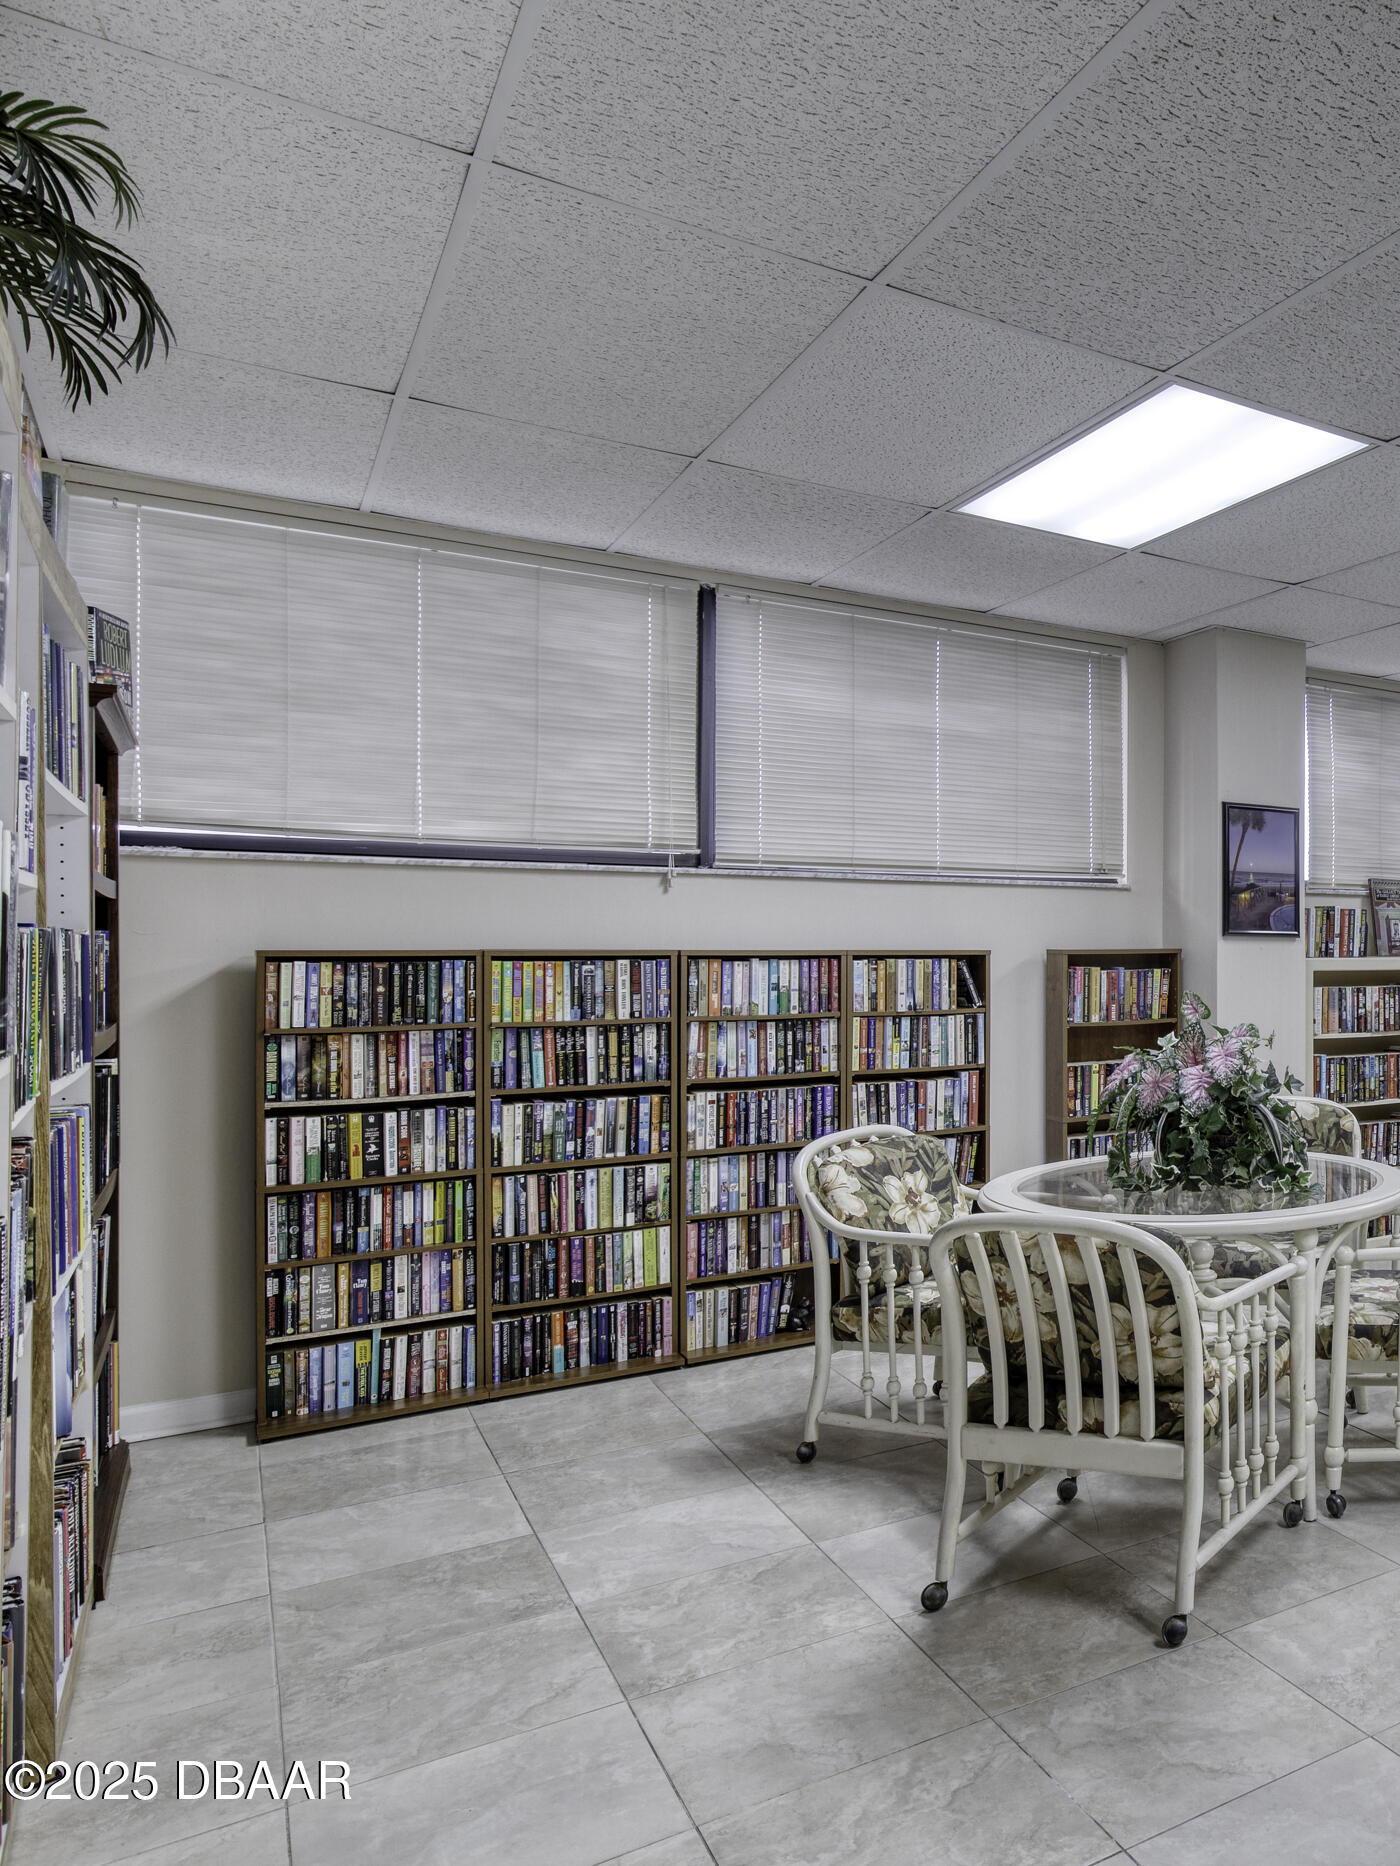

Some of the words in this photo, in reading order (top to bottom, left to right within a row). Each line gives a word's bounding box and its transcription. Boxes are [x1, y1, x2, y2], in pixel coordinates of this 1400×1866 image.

[103, 621, 128, 648] ROBERT
[100, 640, 131, 673] LUDLUM
[266, 1051, 277, 1062] DAN
[266, 1062, 277, 1082] BROWN
